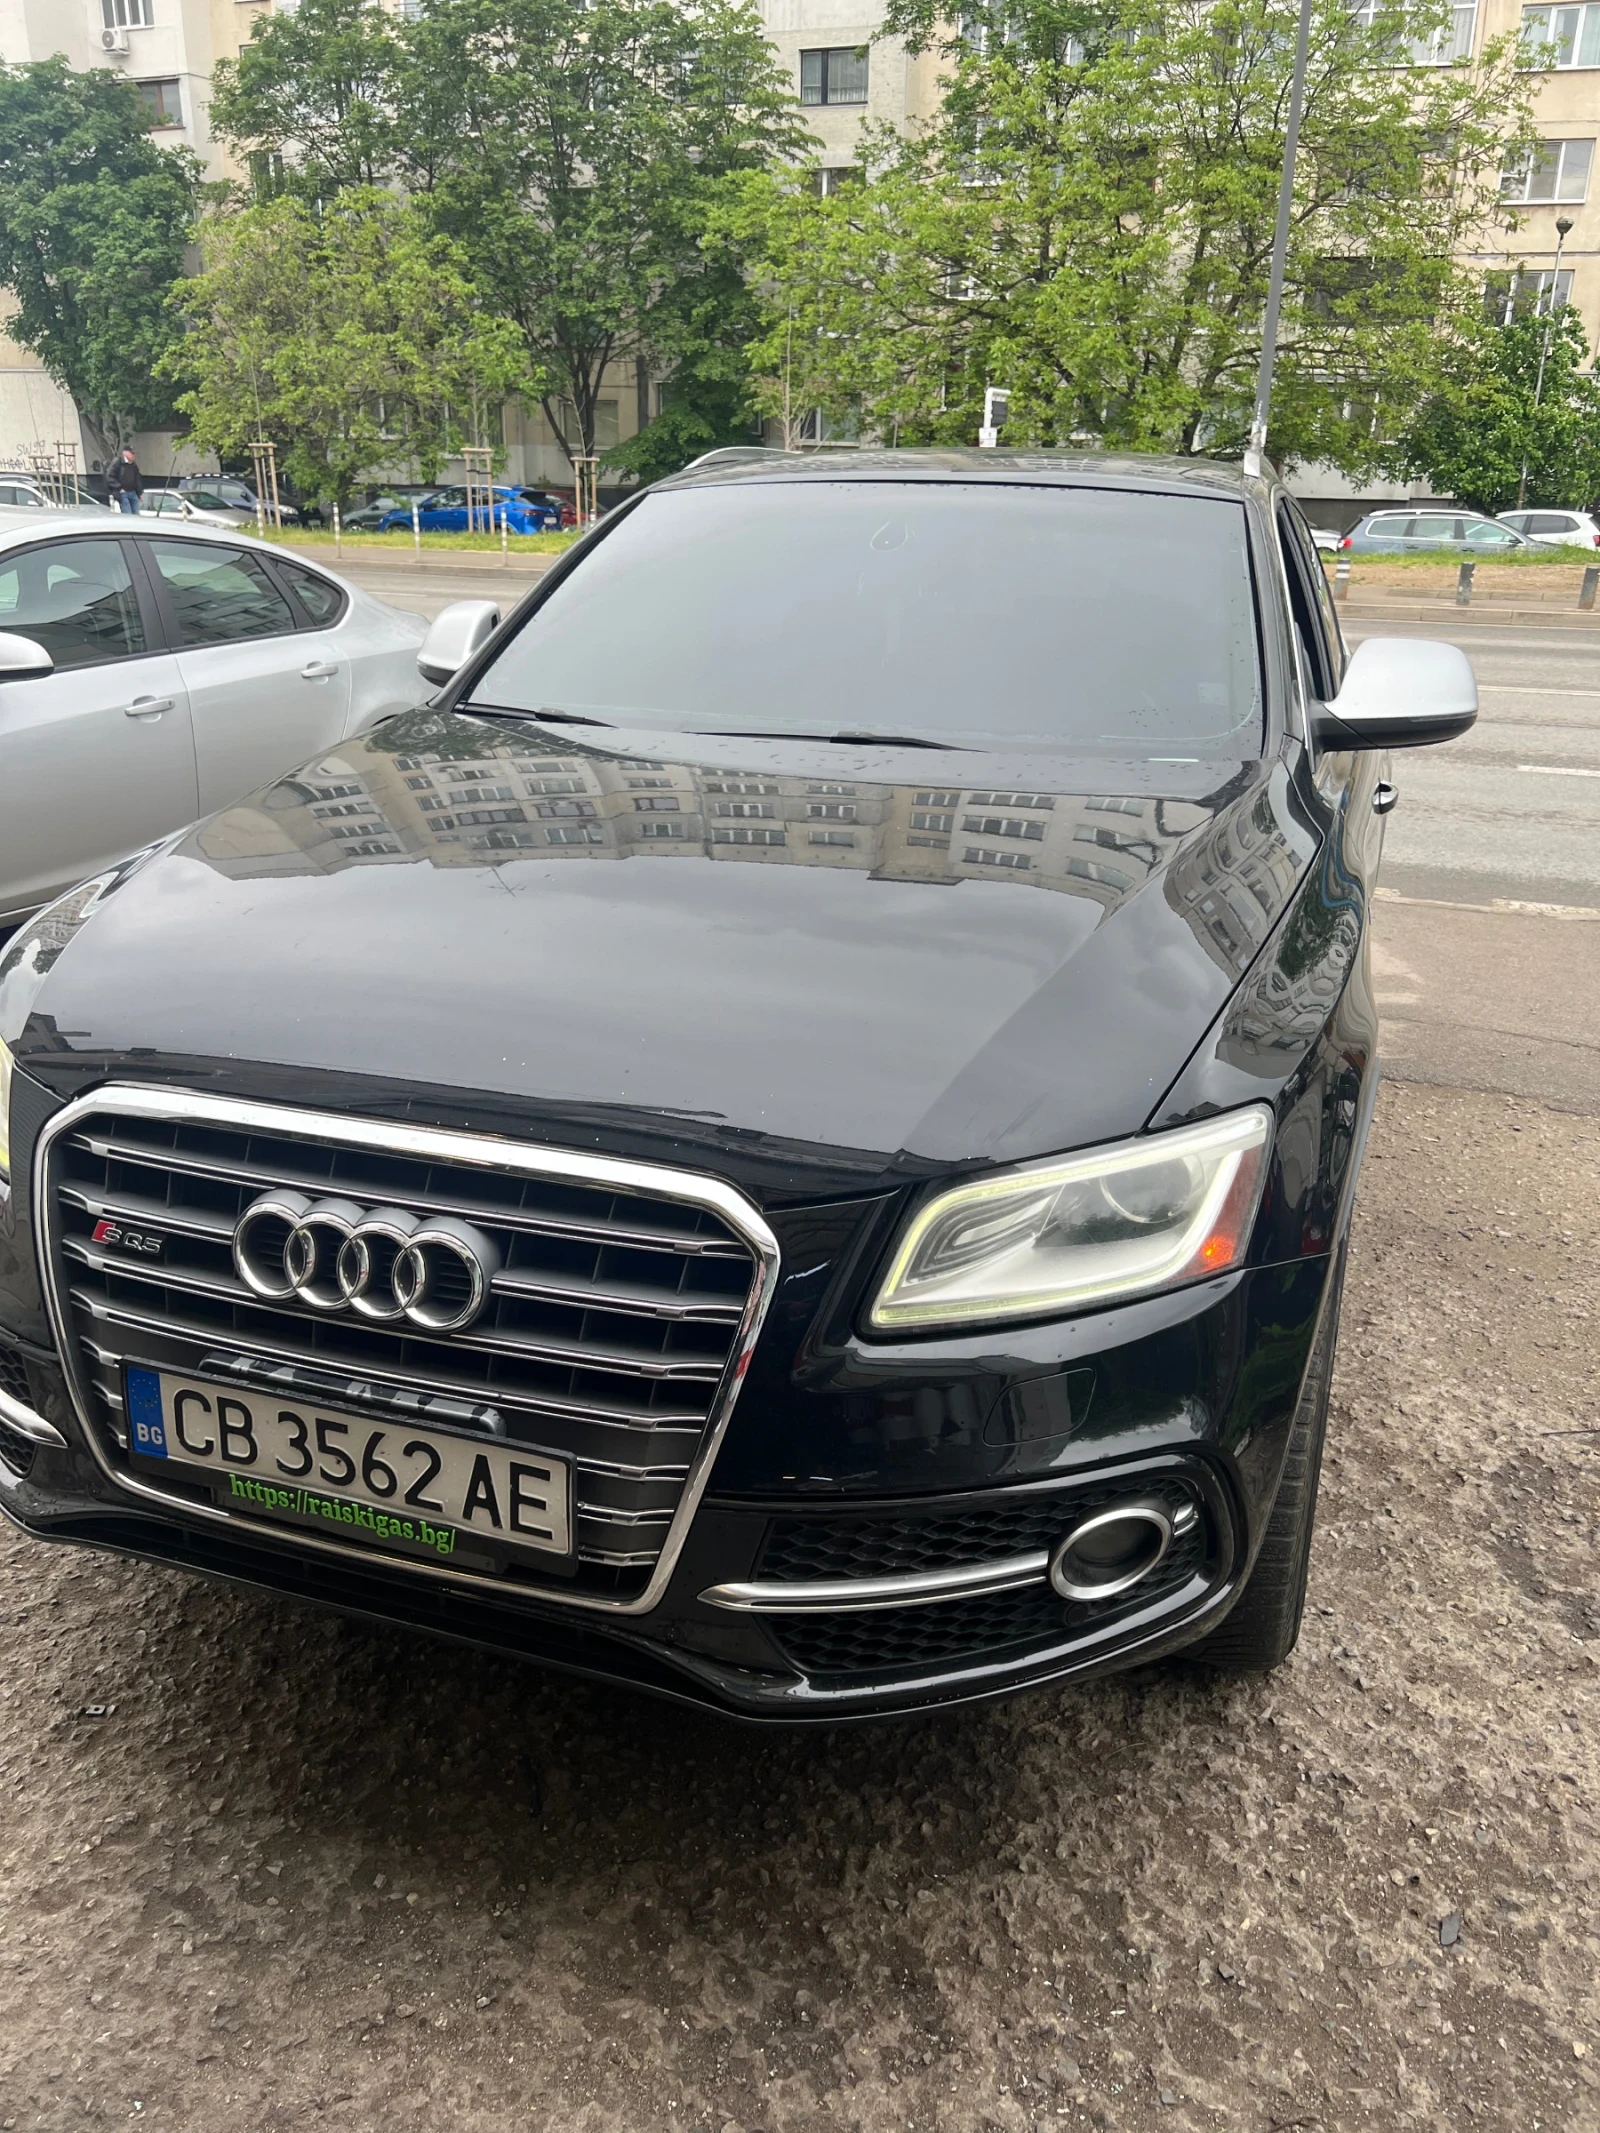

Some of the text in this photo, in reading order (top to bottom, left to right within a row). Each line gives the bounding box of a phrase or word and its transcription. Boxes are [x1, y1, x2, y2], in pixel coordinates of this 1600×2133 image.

[102, 1227, 162, 1253] SQ5
[136, 1423, 163, 1445] BG
[174, 1389, 553, 1540] CB 3562 AE
[229, 1474, 456, 1553] https://raiskigas.bg/
